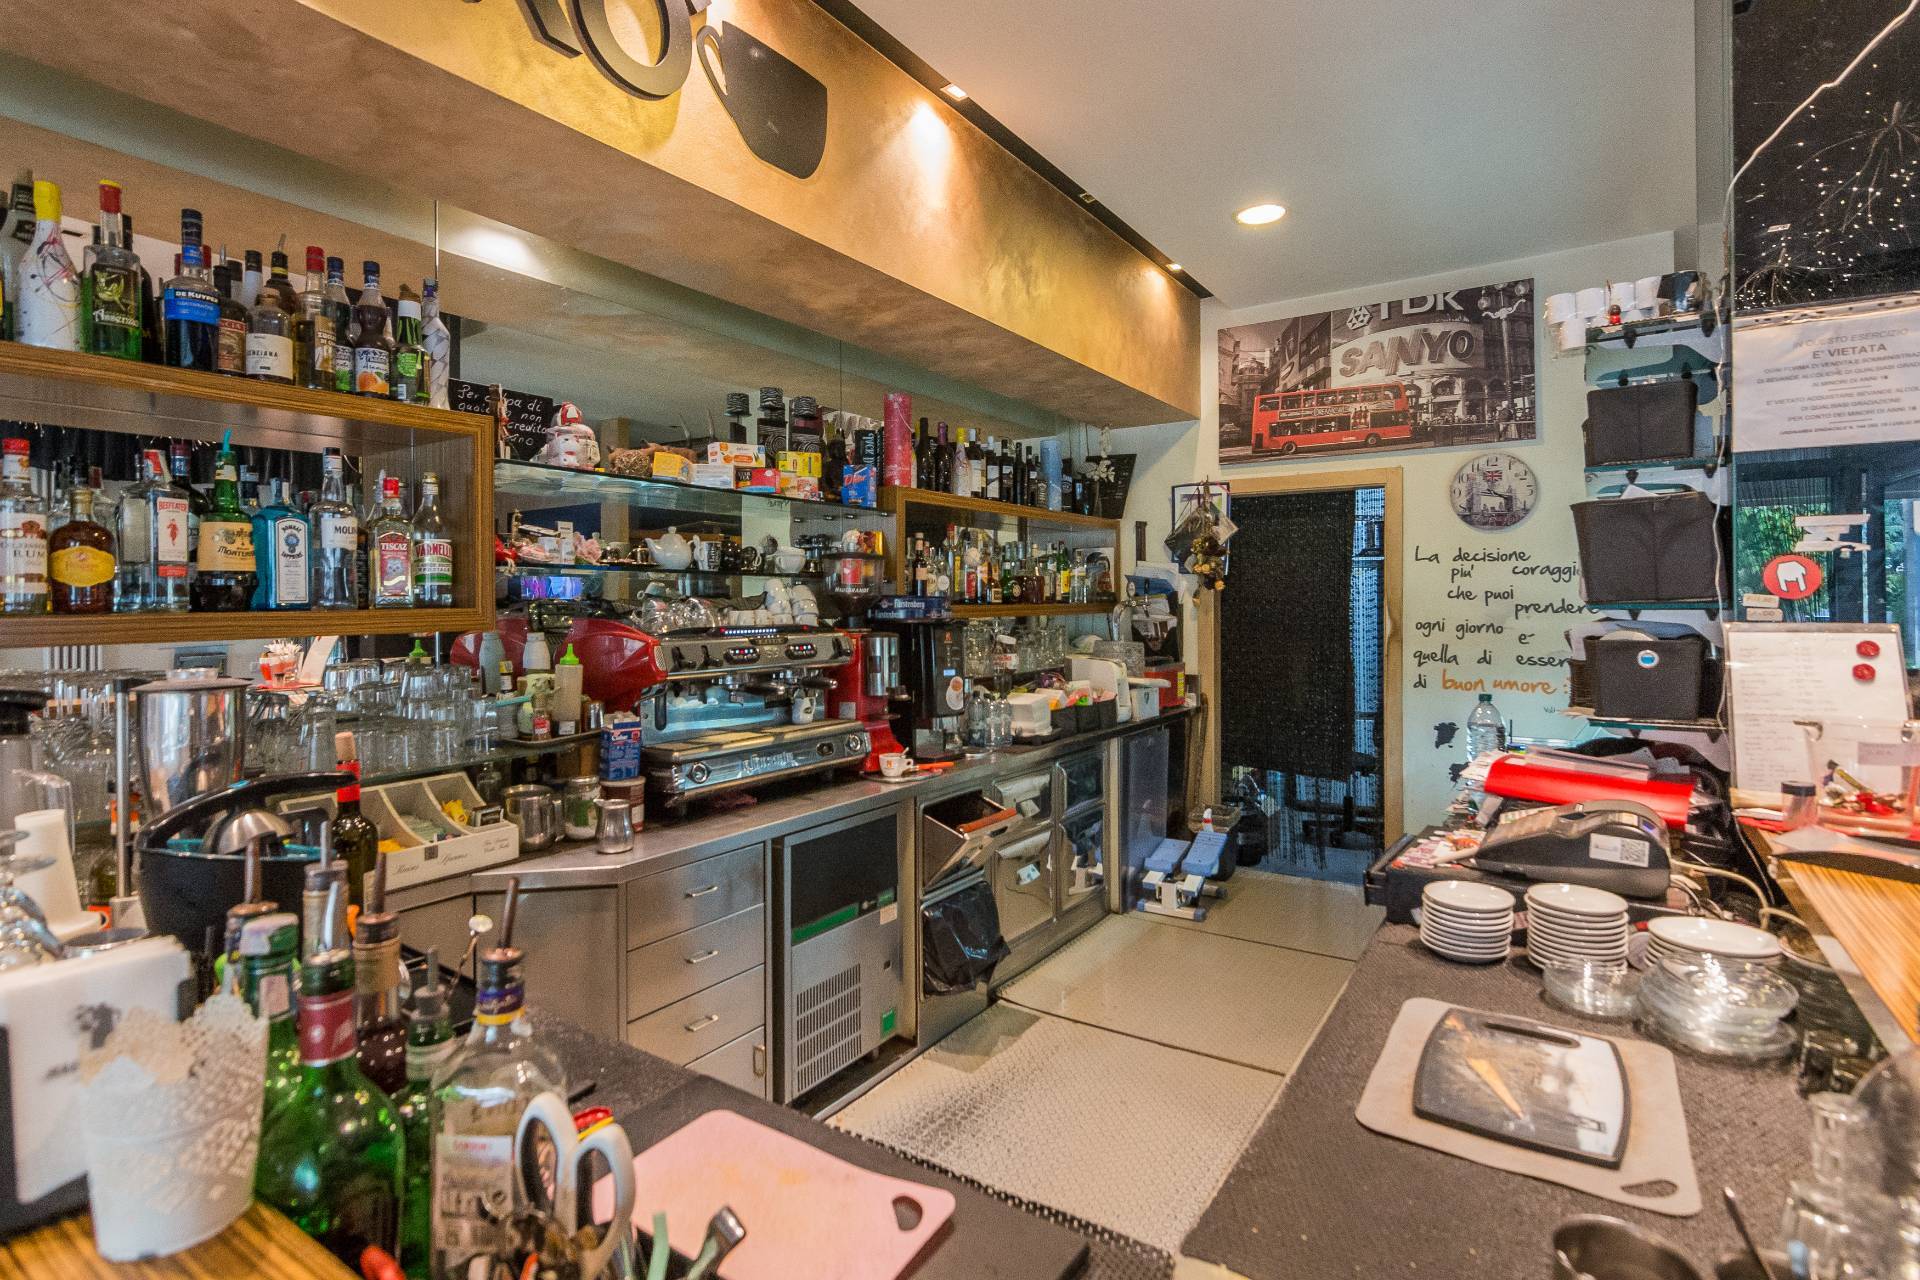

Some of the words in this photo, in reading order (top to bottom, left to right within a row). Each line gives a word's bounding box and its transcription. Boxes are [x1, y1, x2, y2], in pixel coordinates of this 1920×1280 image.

[1339, 329, 1475, 378] SANYO
[1827, 343, 1888, 357] VIETATA
[381, 542, 408, 551] TISCAZ
[1415, 545, 1440, 563] La
[1452, 547, 1531, 562] decisione
[1447, 585, 1477, 600] che
[1484, 585, 1514, 606] puoi
[1415, 618, 1446, 637] ogni
[1455, 619, 1504, 640] giorno
[1413, 643, 1460, 666] quella
[1477, 650, 1492, 665] di
[1413, 674, 1427, 689] di
[1441, 668, 1487, 692] buon
[1493, 679, 1557, 695] umore
